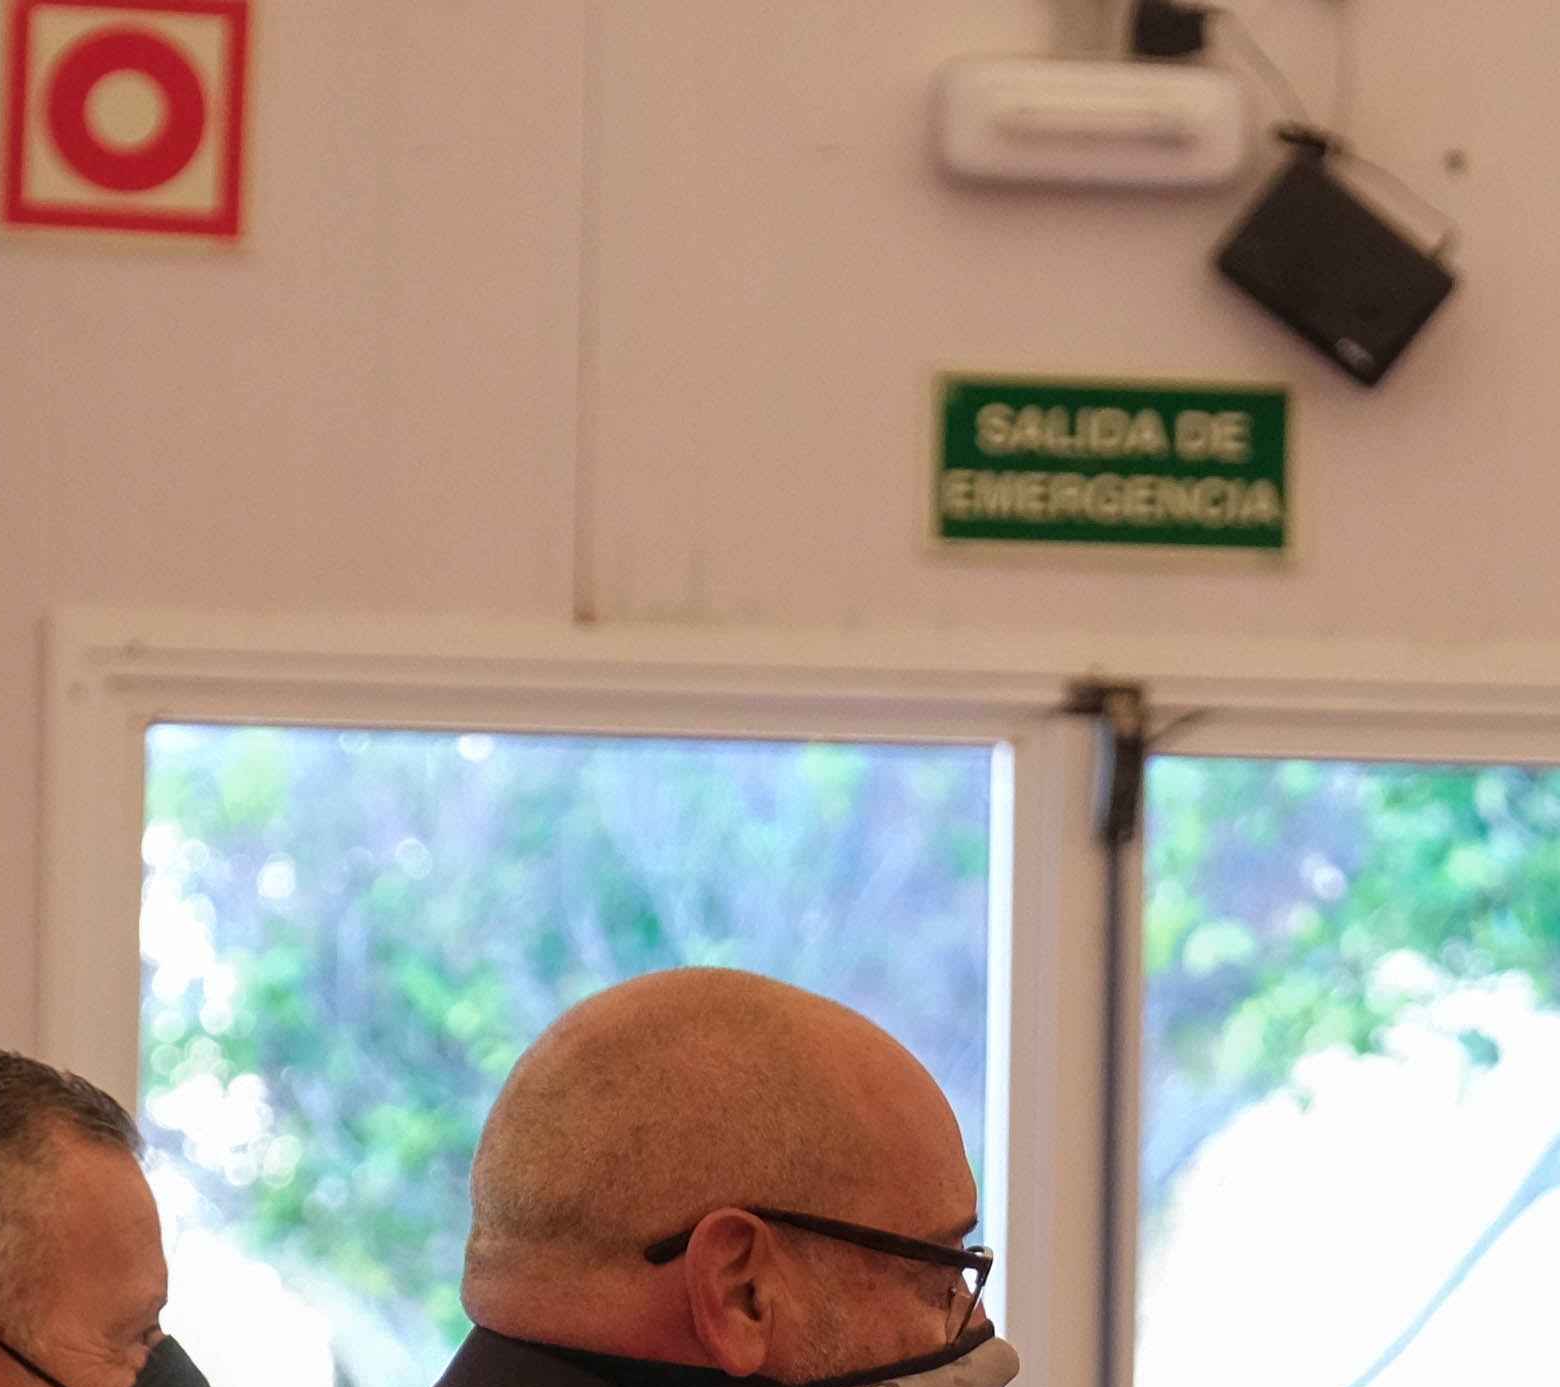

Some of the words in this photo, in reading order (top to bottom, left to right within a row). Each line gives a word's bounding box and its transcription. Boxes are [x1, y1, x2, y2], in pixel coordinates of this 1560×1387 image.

[976, 402, 1171, 458] SALIDA
[1176, 410, 1252, 463] DE
[942, 468, 1280, 528] EMERGENCIA
